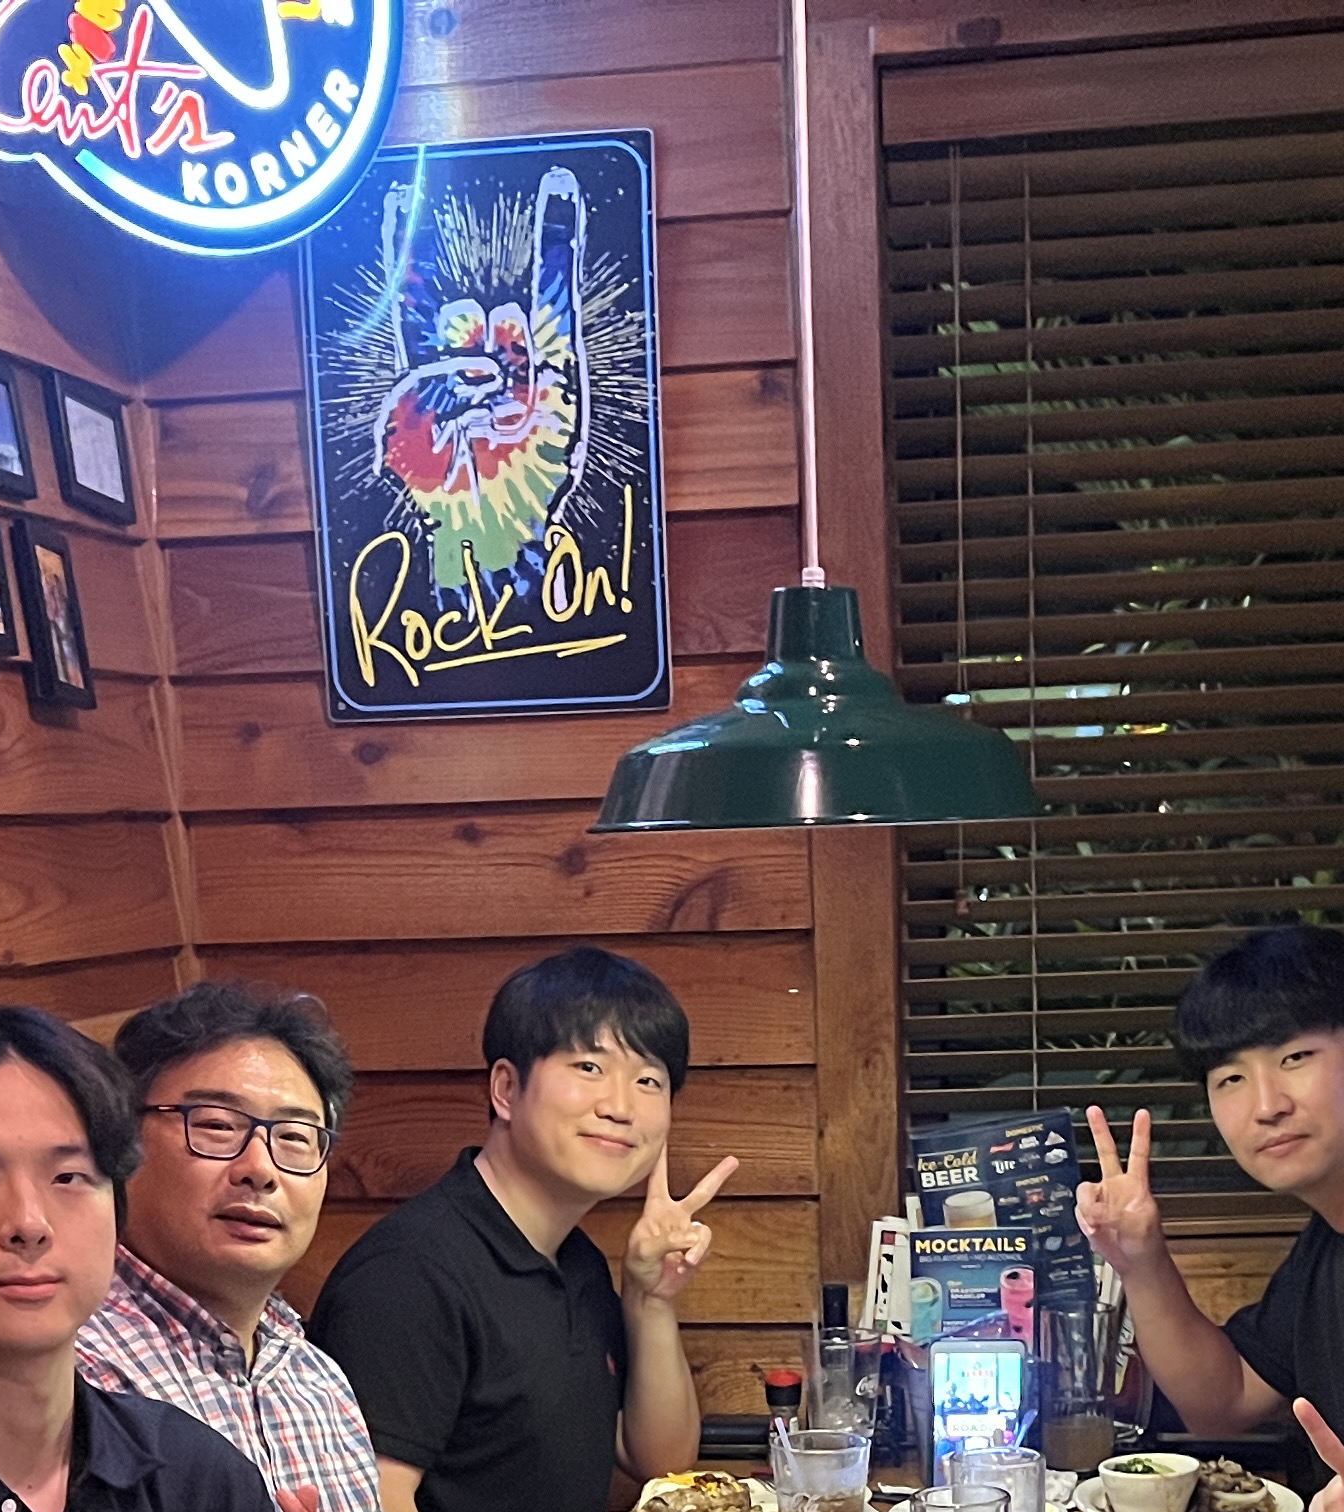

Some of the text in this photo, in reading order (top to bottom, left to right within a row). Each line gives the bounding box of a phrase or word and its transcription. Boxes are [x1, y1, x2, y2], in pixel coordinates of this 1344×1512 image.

[181, 68, 360, 204] KORNER
[350, 484, 633, 687] Rock On!
[917, 1151, 978, 1171] Ice-Cold
[920, 1168, 980, 1188] BEER
[915, 1237, 1026, 1254] MOCKTAILS
